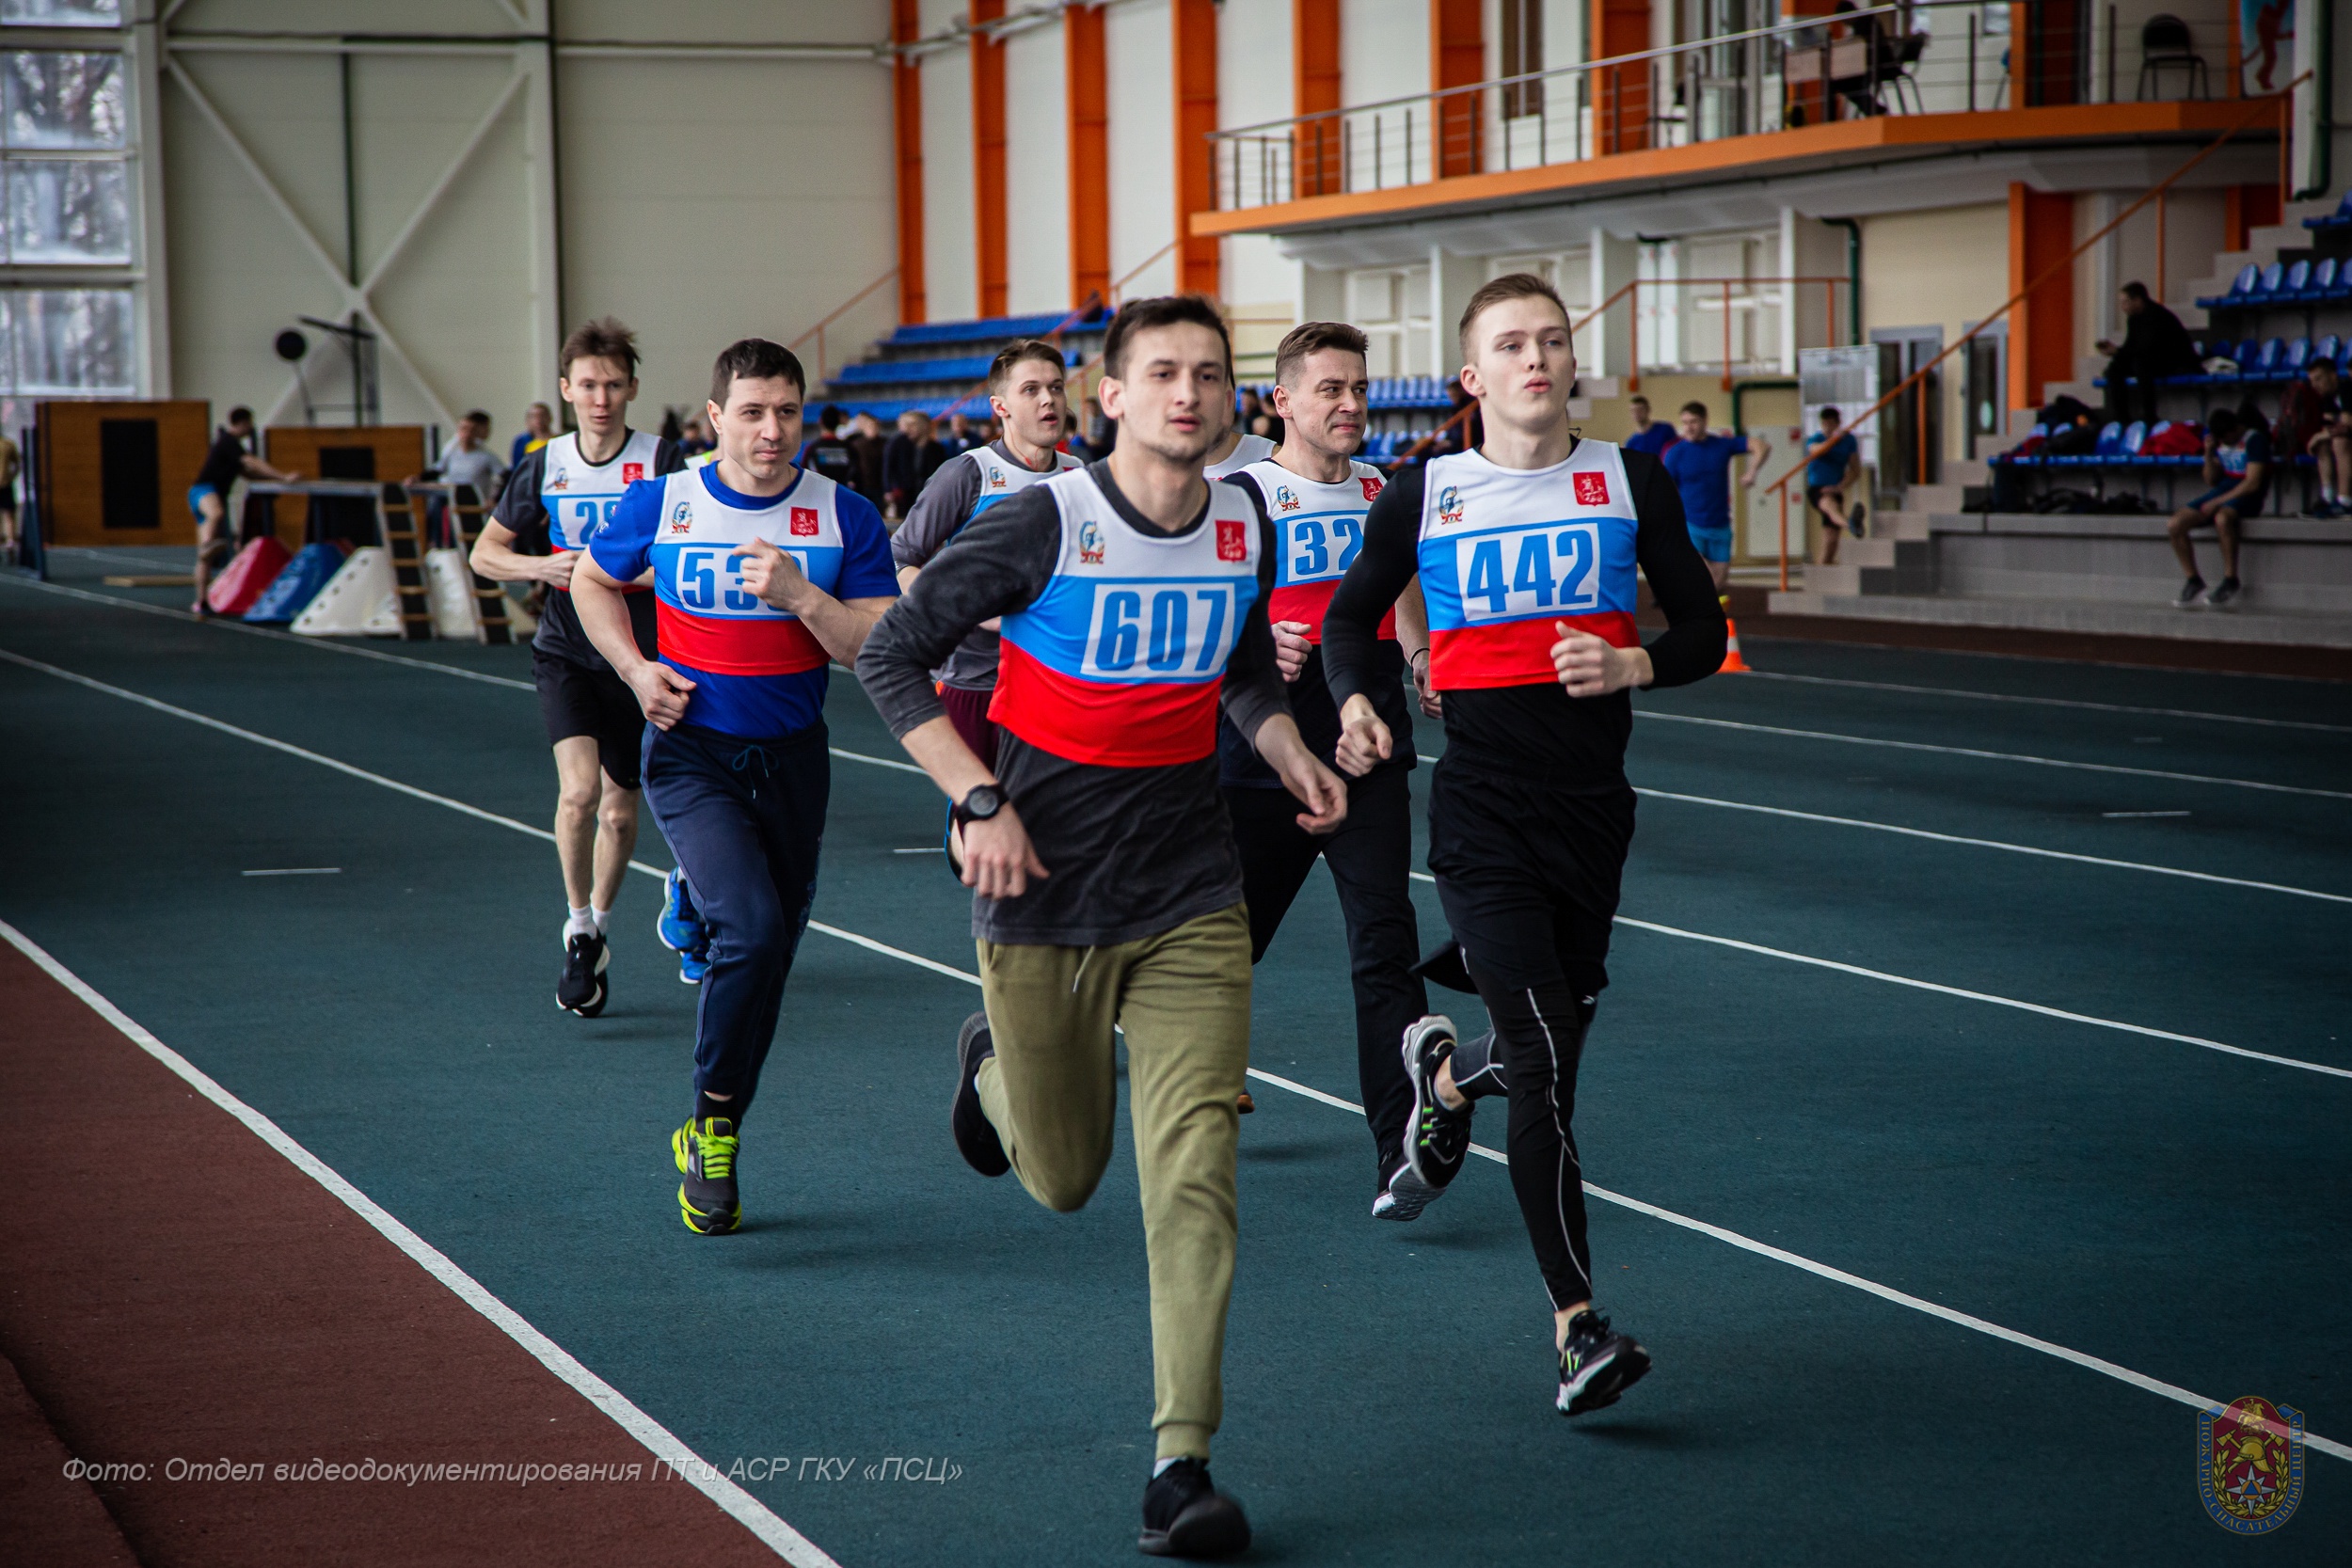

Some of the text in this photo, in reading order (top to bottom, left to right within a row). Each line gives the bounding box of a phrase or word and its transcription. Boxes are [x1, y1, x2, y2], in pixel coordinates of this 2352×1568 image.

[681, 551, 803, 612] 53
[1466, 529, 1594, 614] 442
[1094, 590, 1228, 673] 607
